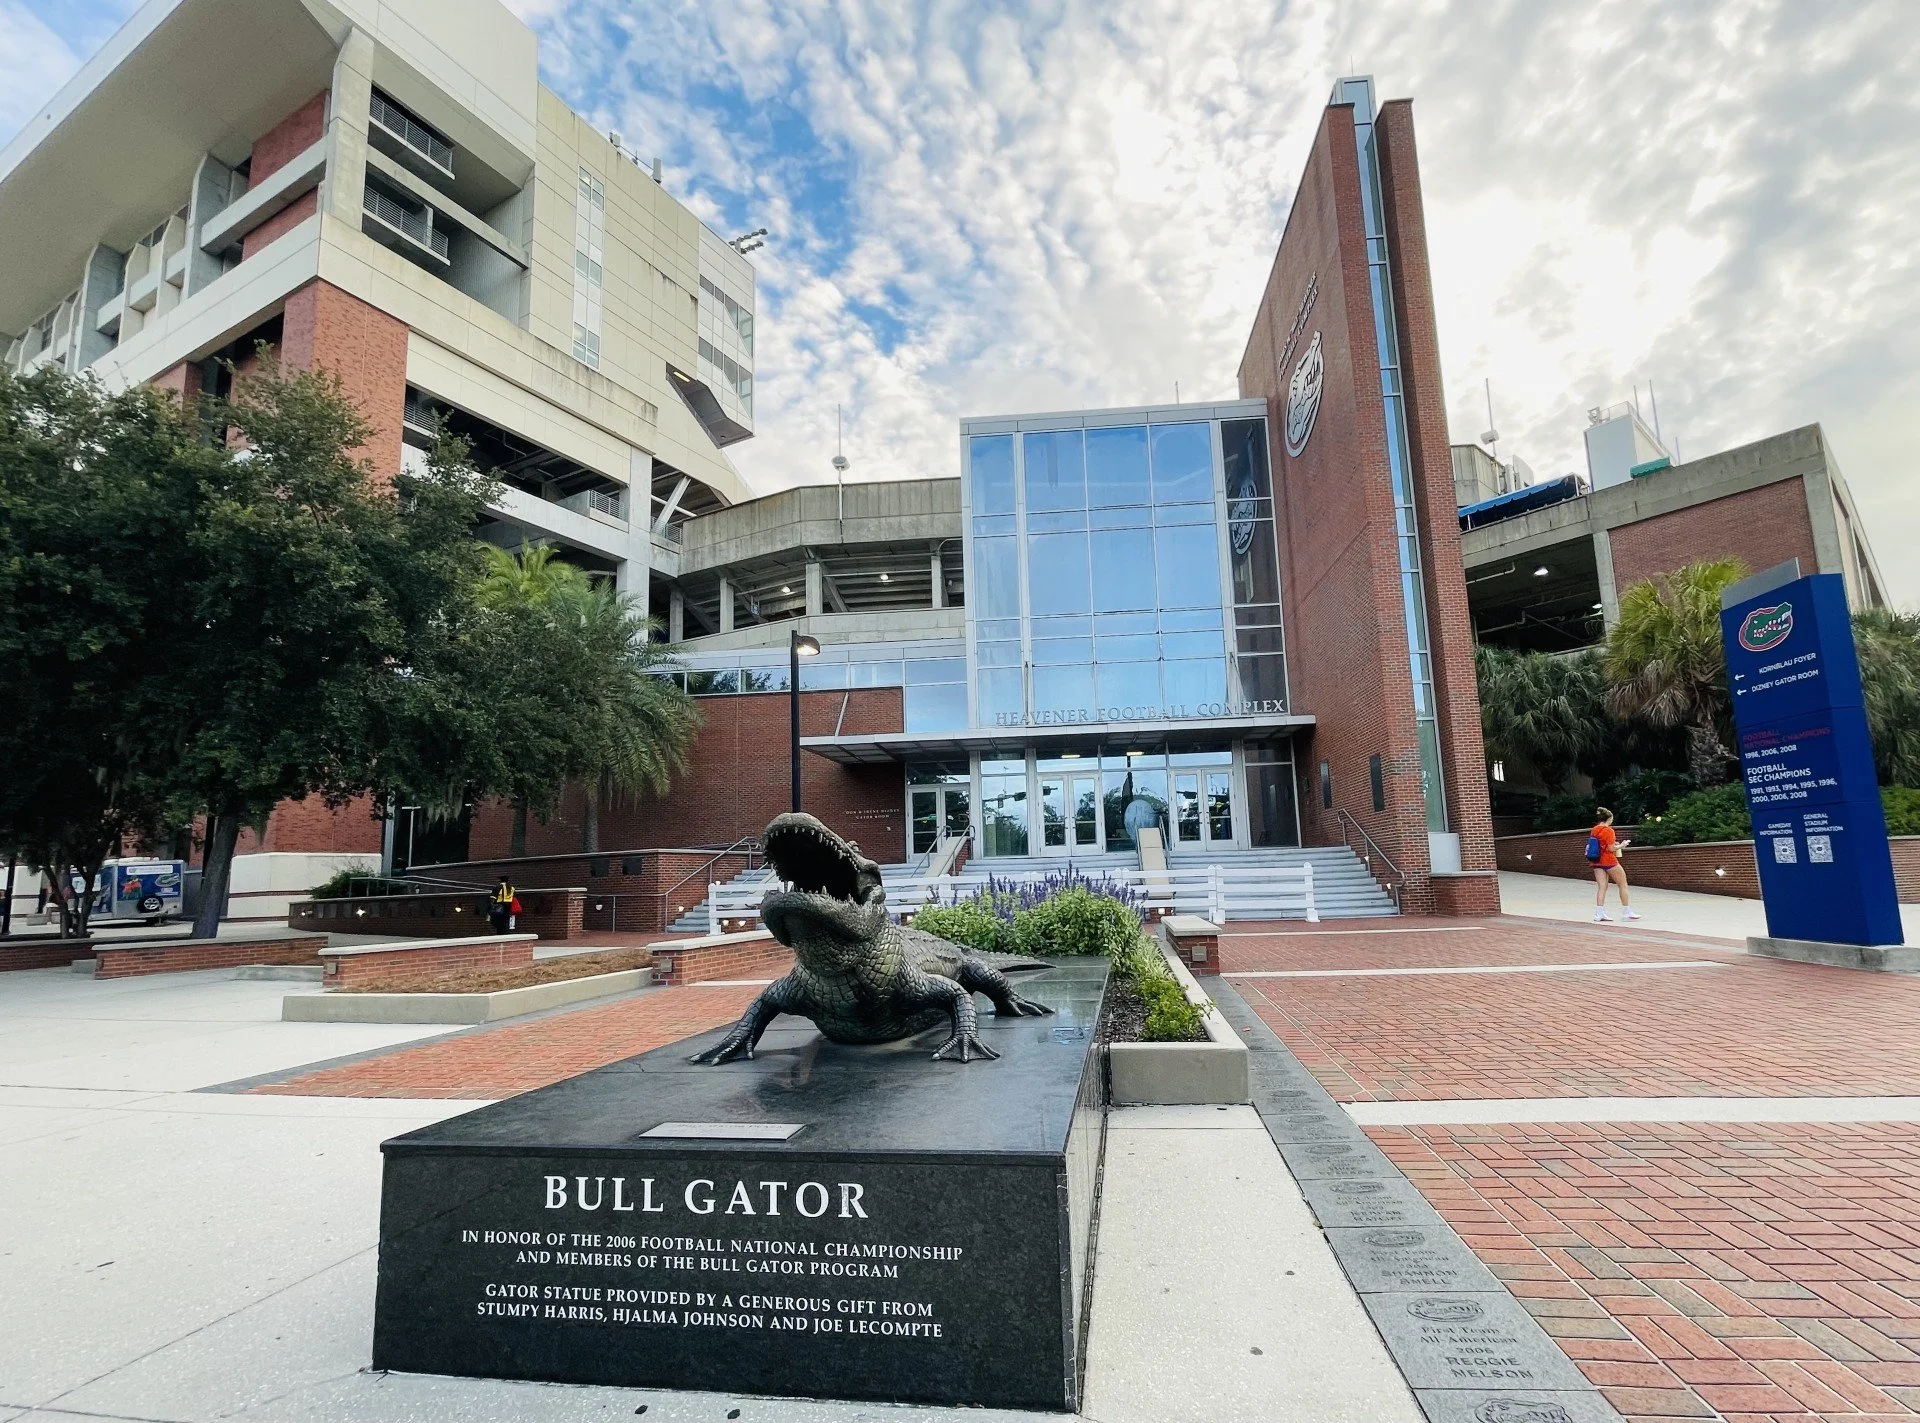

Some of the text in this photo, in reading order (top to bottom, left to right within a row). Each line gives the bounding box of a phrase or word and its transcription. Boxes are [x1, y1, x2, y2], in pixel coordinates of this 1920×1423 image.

[1759, 653, 1817, 674] KORNBLAU FOYER
[1752, 669, 1819, 692] DIZNEY GATOR ROOM
[995, 699, 1285, 726] HEAVENER FOOTBALL COMPLEX
[1743, 729, 1779, 741] FOOTBALL
[1782, 727, 1831, 742] CHAMPIONS
[1761, 748, 1779, 757] 2006,
[1747, 763, 1787, 775] FOOTBALL
[1748, 768, 1811, 784] SEC CHAMPIONS
[1782, 782, 1799, 791] 1994,
[1800, 780, 1817, 789] 1995,
[1818, 777, 1837, 786] 1996,
[1752, 795, 1769, 803] 2000,
[1790, 790, 1807, 799] 2008
[544, 1176, 868, 1218] BULL GATOR
[462, 1230, 963, 1260] IN HONOR OF THE 2006 FOOTBALL NATIONAL CHAMPIONSHIP
[516, 1251, 898, 1278] AND MEMBERS OF THE BULL GATOR PROGRAM
[485, 1283, 933, 1317] GATOR STATUE PROVIDED BY A GENEROUS GIFT FROM
[477, 1302, 942, 1337] STUMPY HARRIS, HJALMA JOHNSON AND JOE LECOMPTE
[1421, 1325, 1501, 1335] First Team
[1420, 1334, 1518, 1345] All-American
[1445, 1356, 1523, 1367] REGGIE
[1450, 1368, 1534, 1379] NELSON
